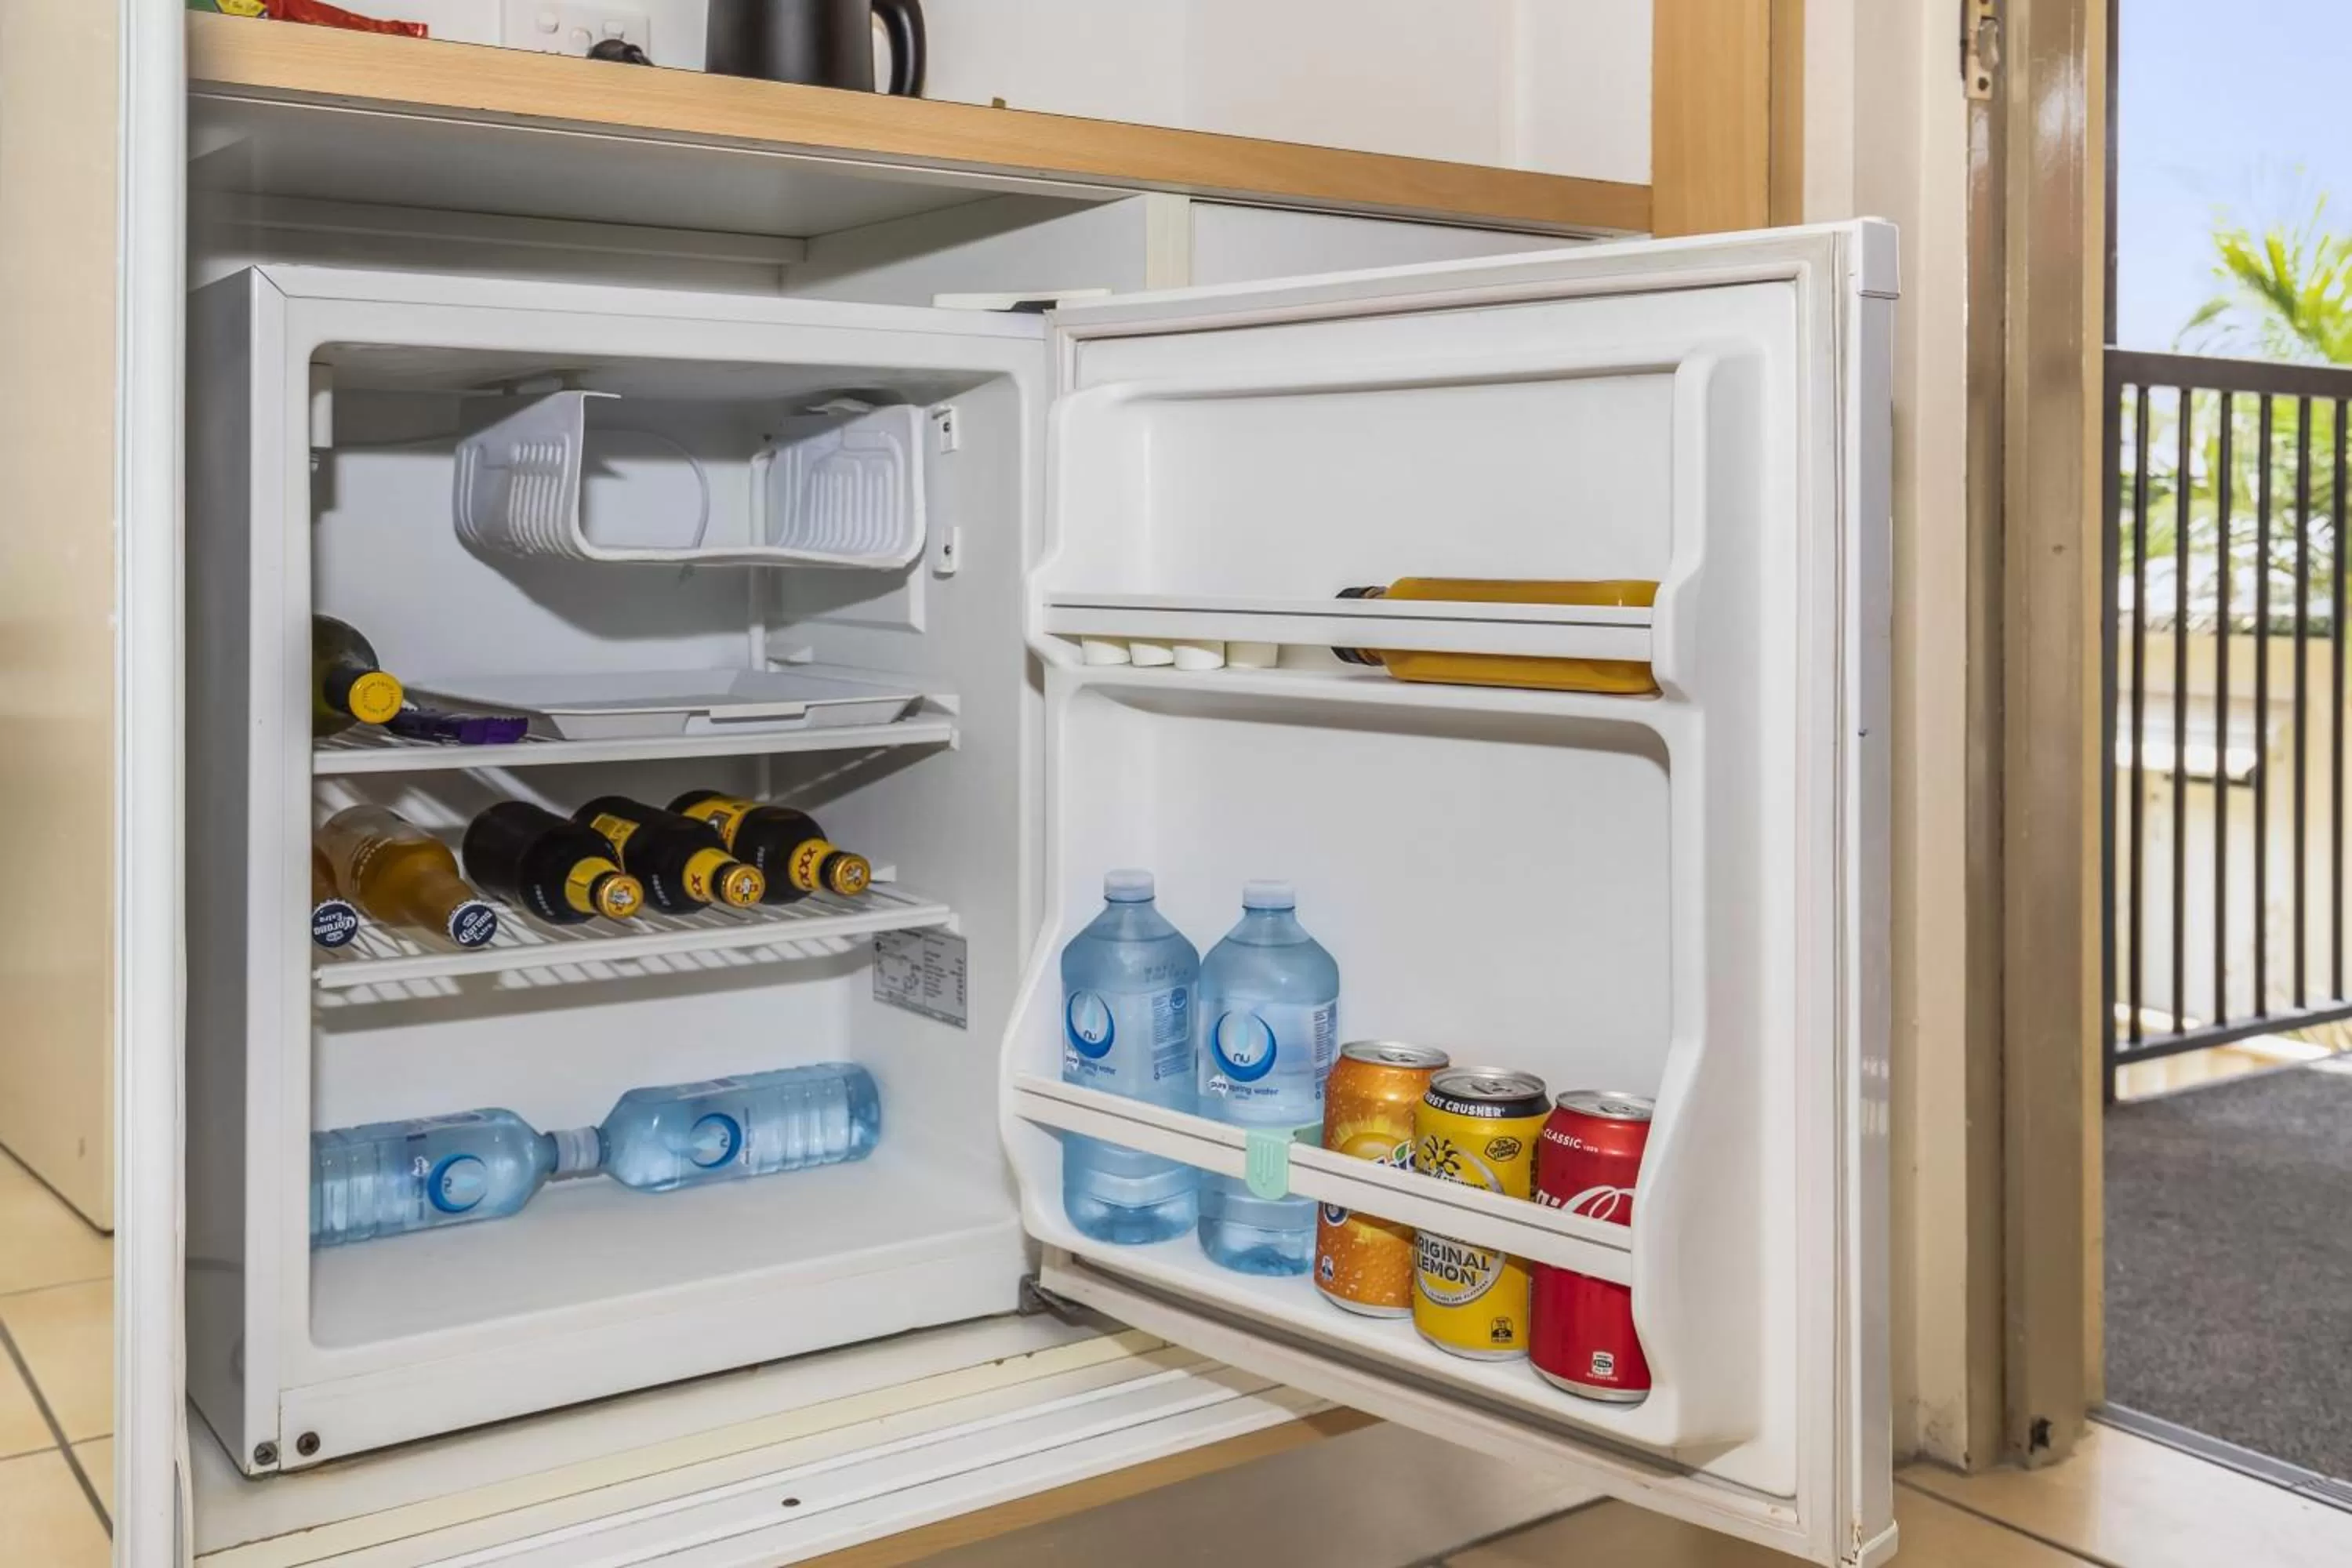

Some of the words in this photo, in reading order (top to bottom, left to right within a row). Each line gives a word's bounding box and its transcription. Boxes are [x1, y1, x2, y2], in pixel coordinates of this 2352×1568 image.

[314, 916, 356, 935] Corona
[319, 912, 343, 923] Extra
[459, 910, 492, 943] Corona
[1083, 1029, 1097, 1041] nu
[1233, 1053, 1250, 1064] nu
[1445, 1101, 1502, 1117] CRUSHER
[1544, 1128, 1582, 1149] CLASSIC
[1417, 1236, 1490, 1272] RIGINAL
[1417, 1253, 1477, 1287] LEMON
